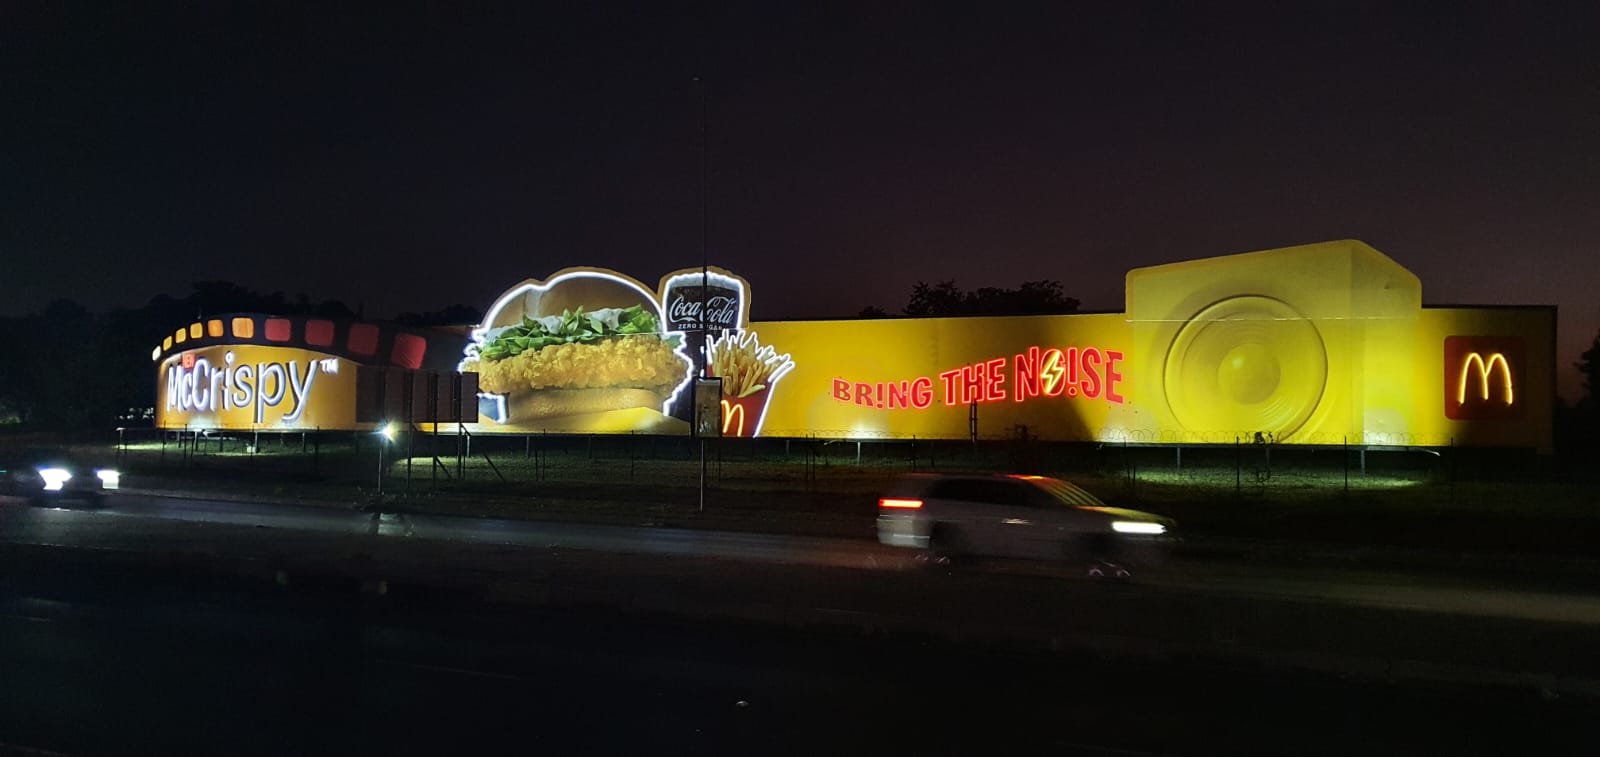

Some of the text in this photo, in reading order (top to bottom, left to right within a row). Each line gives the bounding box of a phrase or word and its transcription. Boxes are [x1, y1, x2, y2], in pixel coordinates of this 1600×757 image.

[699, 323, 723, 331] SGAR
[940, 358, 1006, 406] THE
[1458, 352, 1513, 405] M
